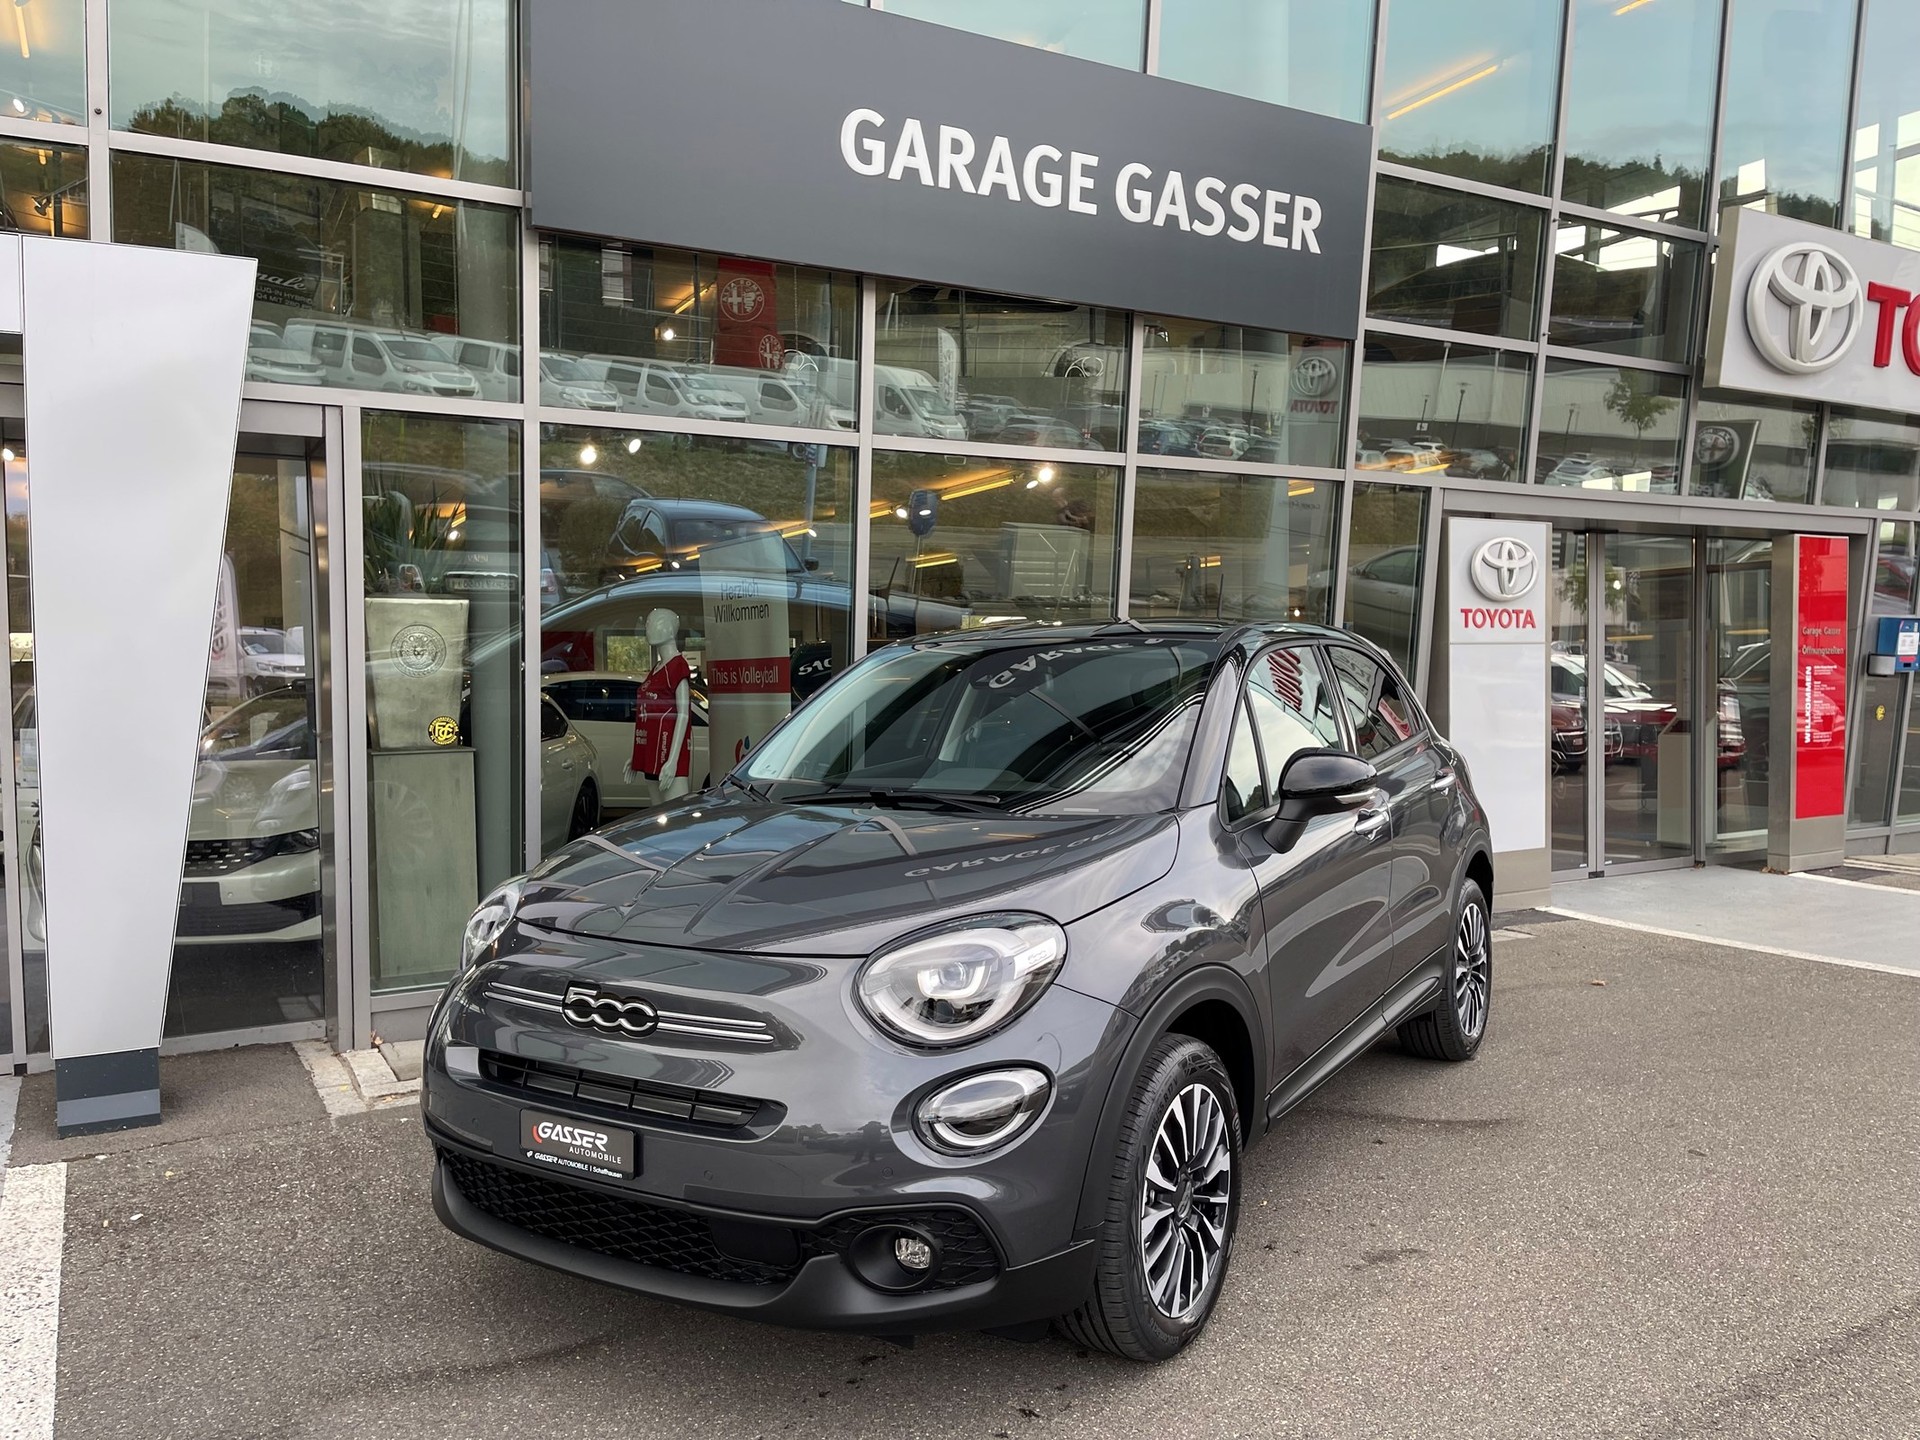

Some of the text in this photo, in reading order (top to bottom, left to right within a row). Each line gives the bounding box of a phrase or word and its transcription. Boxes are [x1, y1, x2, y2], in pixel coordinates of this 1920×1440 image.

[840, 108, 1322, 254] GARAGE GASSER
[721, 579, 760, 601] Herzlich
[713, 602, 770, 624] Willkommen
[1460, 608, 1536, 629] TOYOTA
[1802, 626, 1822, 638] Garage
[711, 668, 729, 686] This
[730, 667, 738, 684] is
[1804, 665, 1812, 744] WILLKOMMEN
[564, 986, 655, 1032] 500
[538, 1121, 608, 1152] GASSER
[534, 1152, 558, 1164] GASSER
[558, 1158, 589, 1171] AUTOMOBILE
[593, 1166, 623, 1179] Schaffhausen
[569, 1146, 622, 1165] AUTOMOBILE
